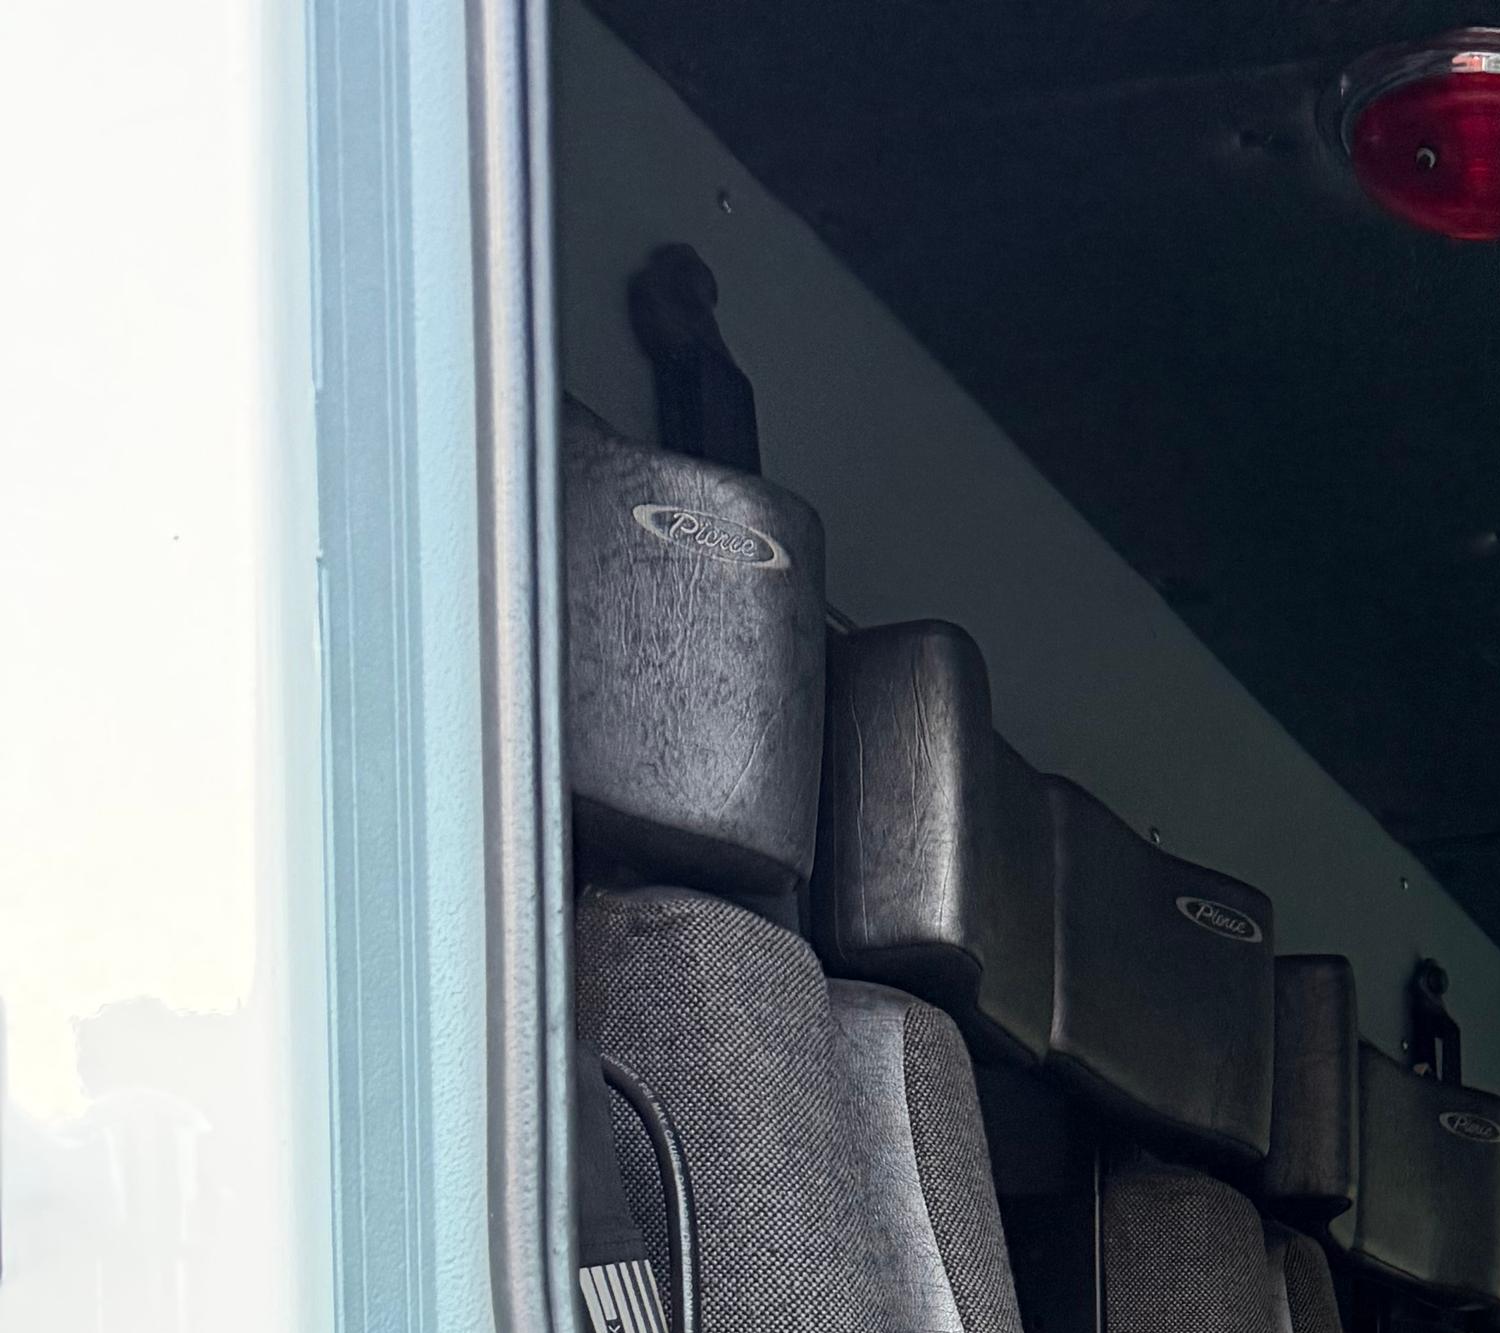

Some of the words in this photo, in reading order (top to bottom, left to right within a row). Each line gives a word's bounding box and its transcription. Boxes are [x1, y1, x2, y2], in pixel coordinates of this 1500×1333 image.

[669, 512, 755, 557] Pierce
[652, 1102, 668, 1126] MAY
[664, 1129, 682, 1168] CAUSE
[682, 1256, 694, 1321] PERSONAL
